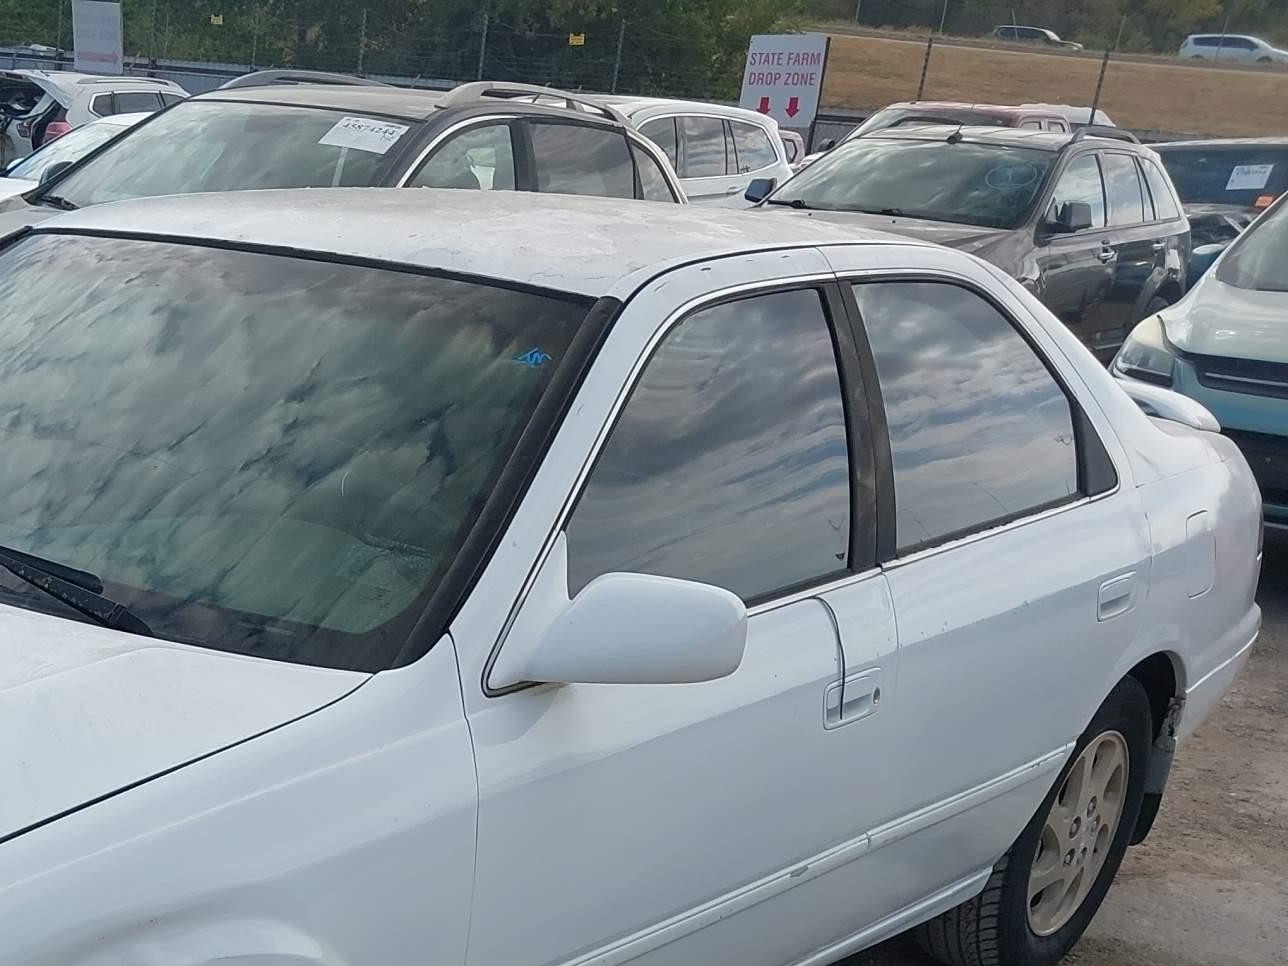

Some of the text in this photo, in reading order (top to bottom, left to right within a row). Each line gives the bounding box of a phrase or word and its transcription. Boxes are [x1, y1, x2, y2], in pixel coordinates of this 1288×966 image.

[749, 52, 822, 67] STATE FARM
[747, 71, 817, 87] DROP ZONE
